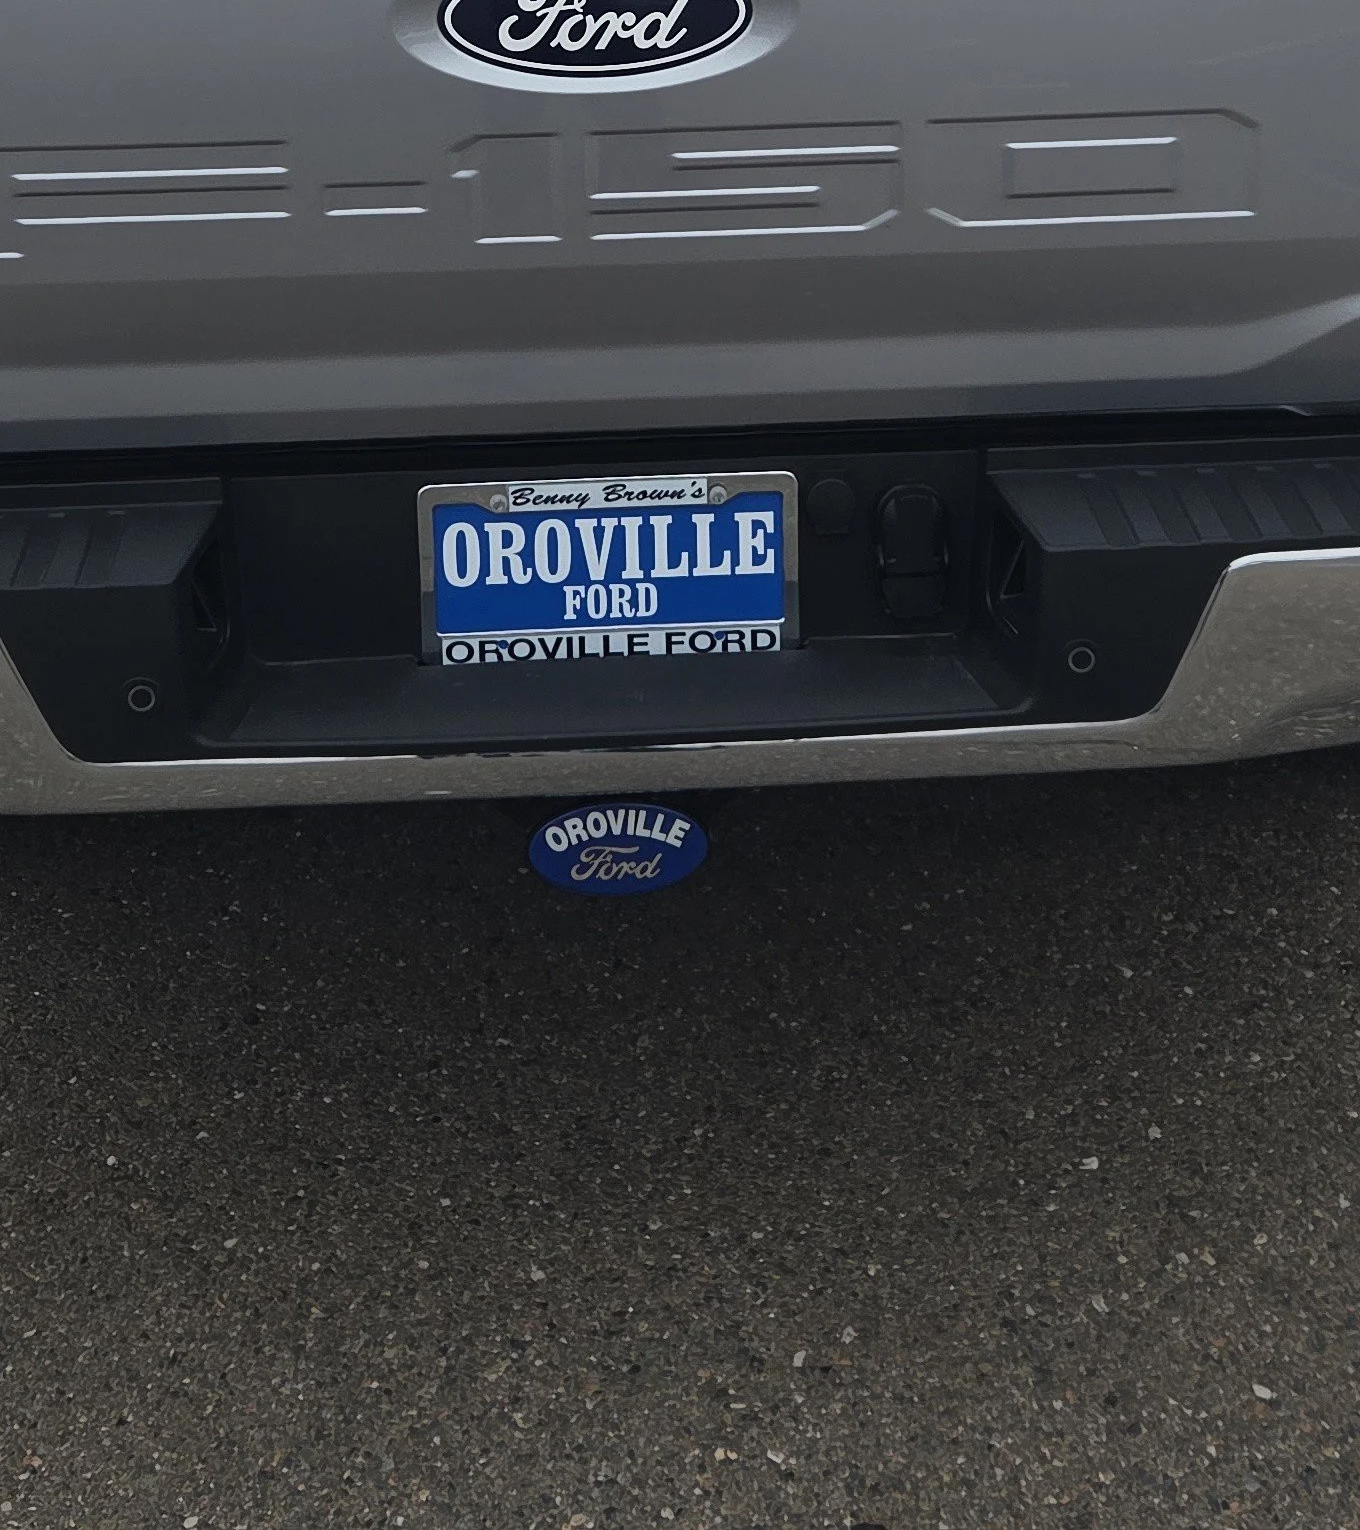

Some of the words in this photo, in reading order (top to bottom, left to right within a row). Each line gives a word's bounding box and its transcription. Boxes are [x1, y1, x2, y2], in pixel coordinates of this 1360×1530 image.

[511, 486, 591, 509] Benny
[602, 481, 706, 503] Brown's
[442, 510, 776, 588] OROVILLE
[563, 582, 658, 620] FORD
[445, 632, 651, 664] OROVILLE
[664, 627, 777, 656] FORD
[544, 808, 692, 852] OROVILLE
[570, 844, 663, 882] Ford
